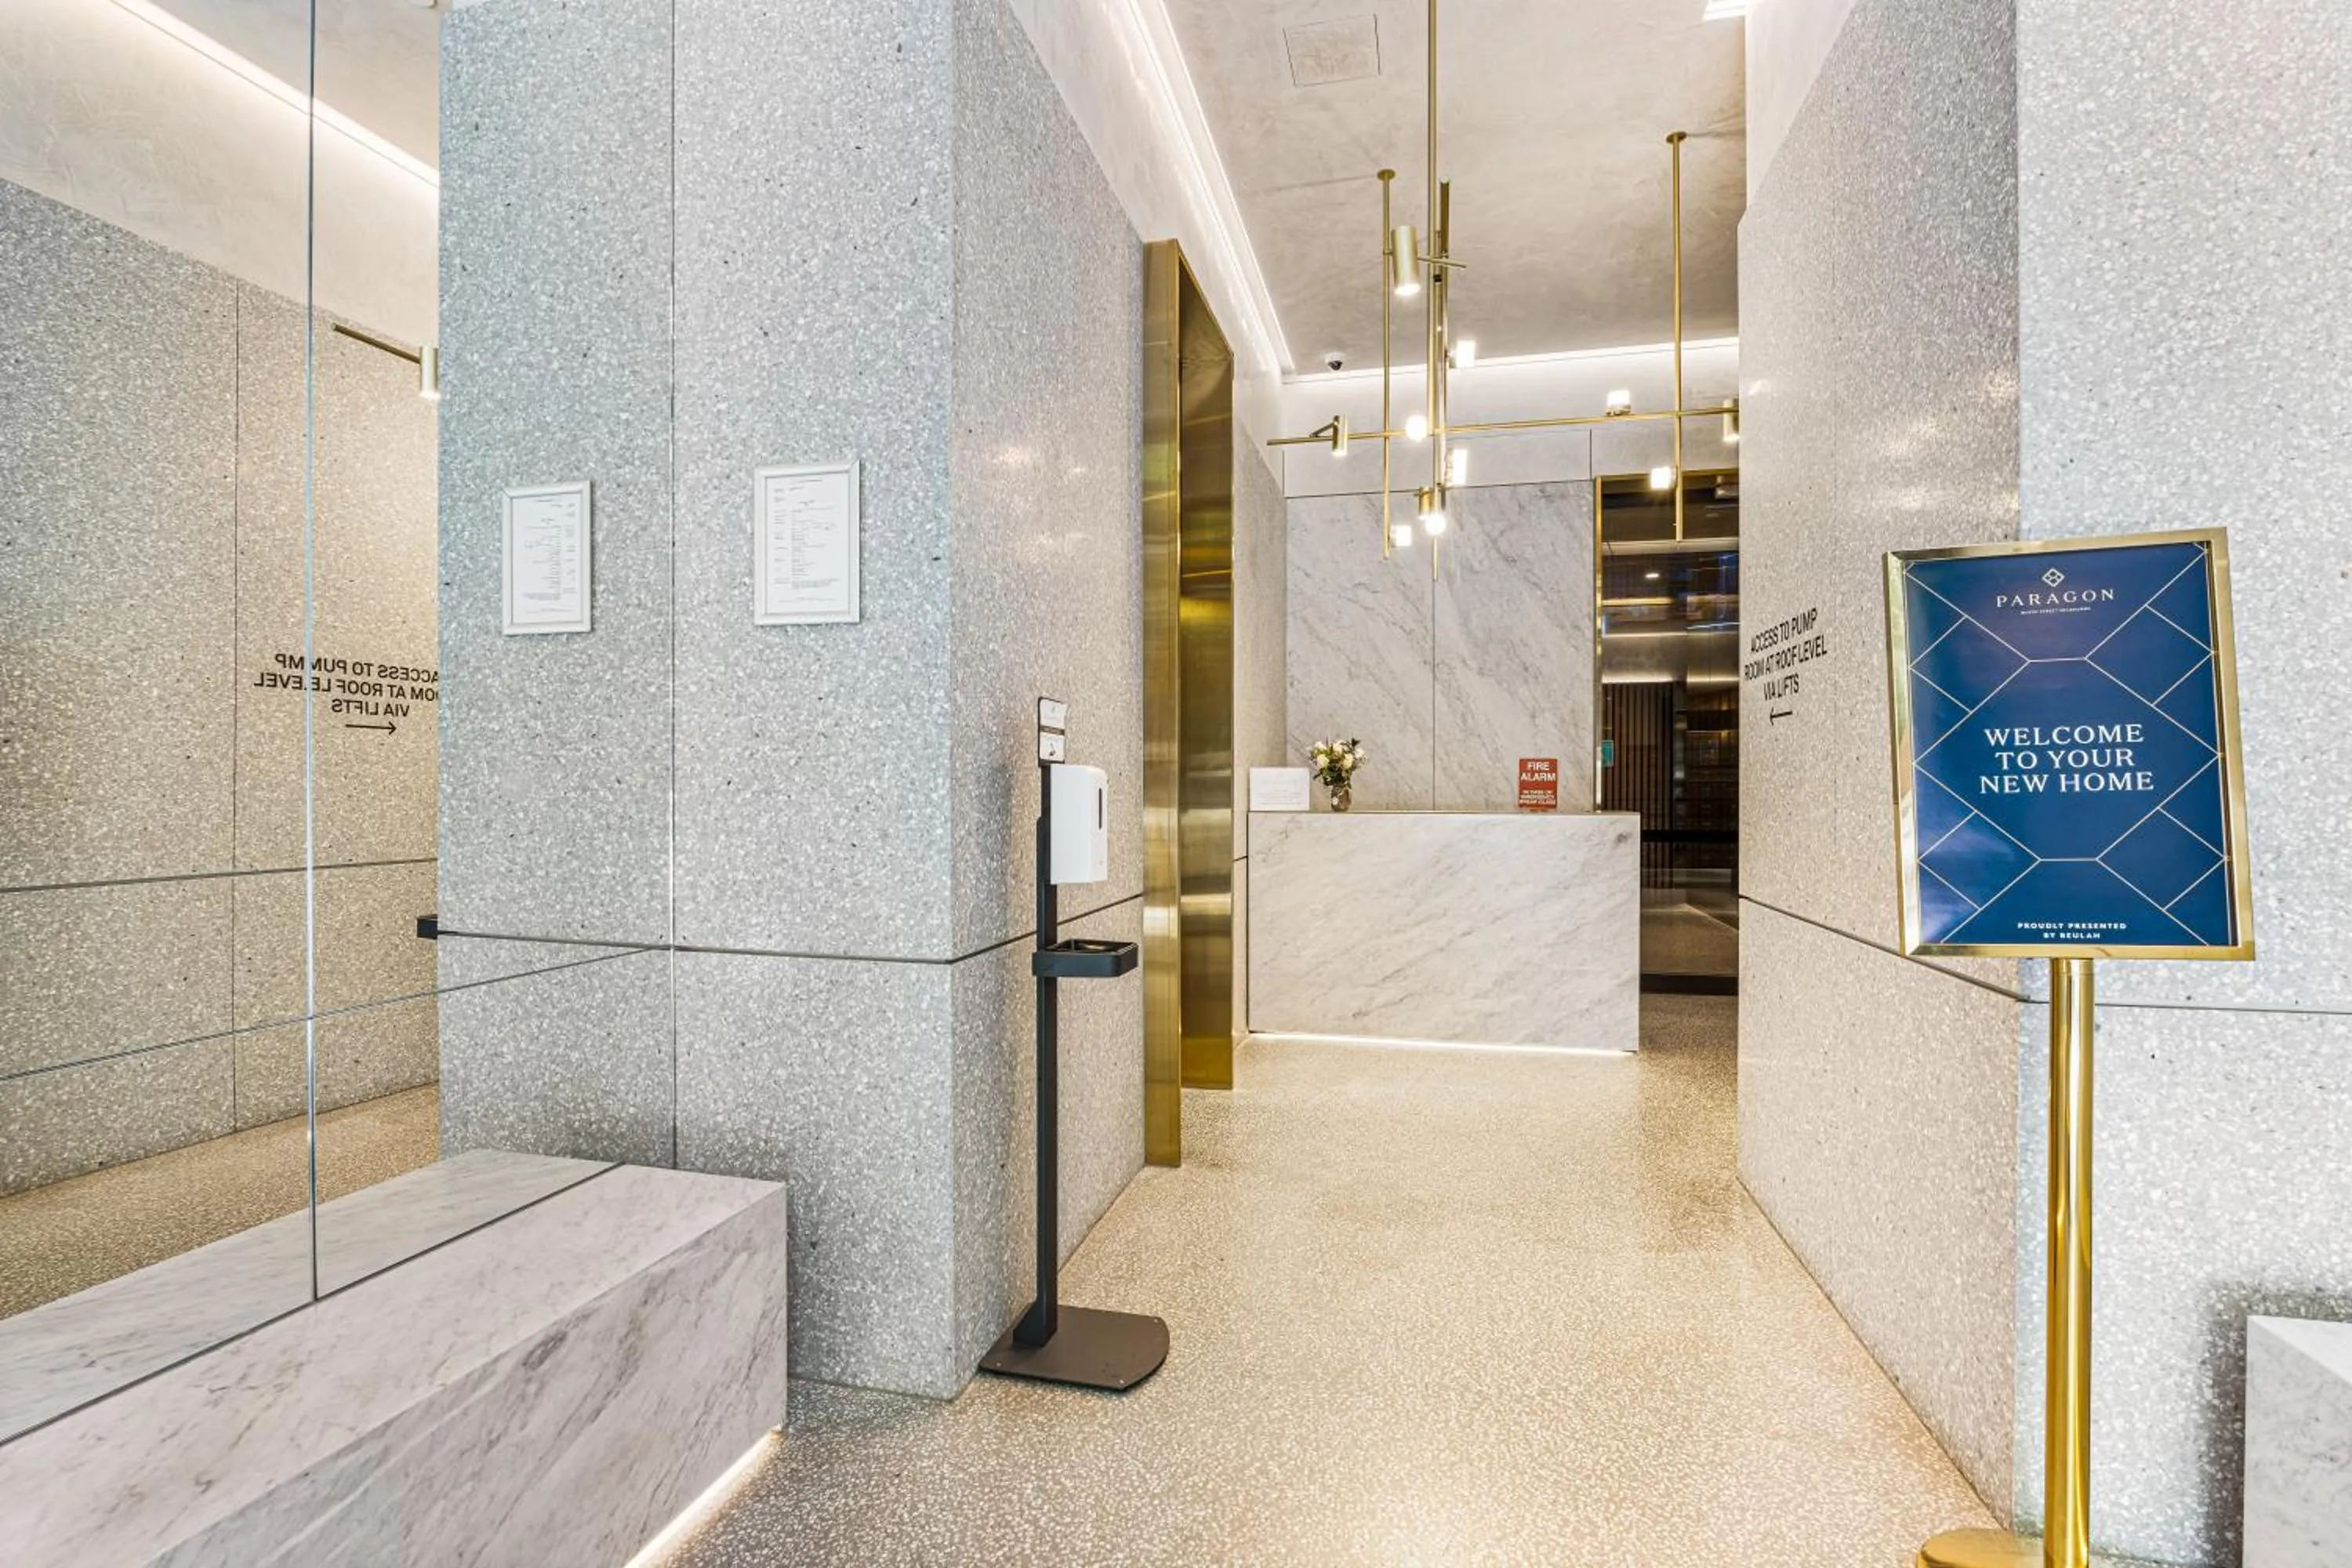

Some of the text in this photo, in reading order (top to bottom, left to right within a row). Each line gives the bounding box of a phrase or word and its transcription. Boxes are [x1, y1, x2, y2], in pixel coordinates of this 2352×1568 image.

[1996, 588, 2114, 608] PARAGON
[1751, 608, 1818, 653] ACCESS TO PUMP
[1744, 633, 1828, 681] ROOM AT ROOF LEVEL
[1763, 672, 1799, 701] VIA LIFTS
[1984, 723, 2145, 746] WELCOME
[1527, 761, 1550, 771] FIRE
[1994, 747, 2136, 771] TO YOUR
[1520, 772, 1556, 782] ALARM
[1979, 771, 2154, 794] NEW HOME
